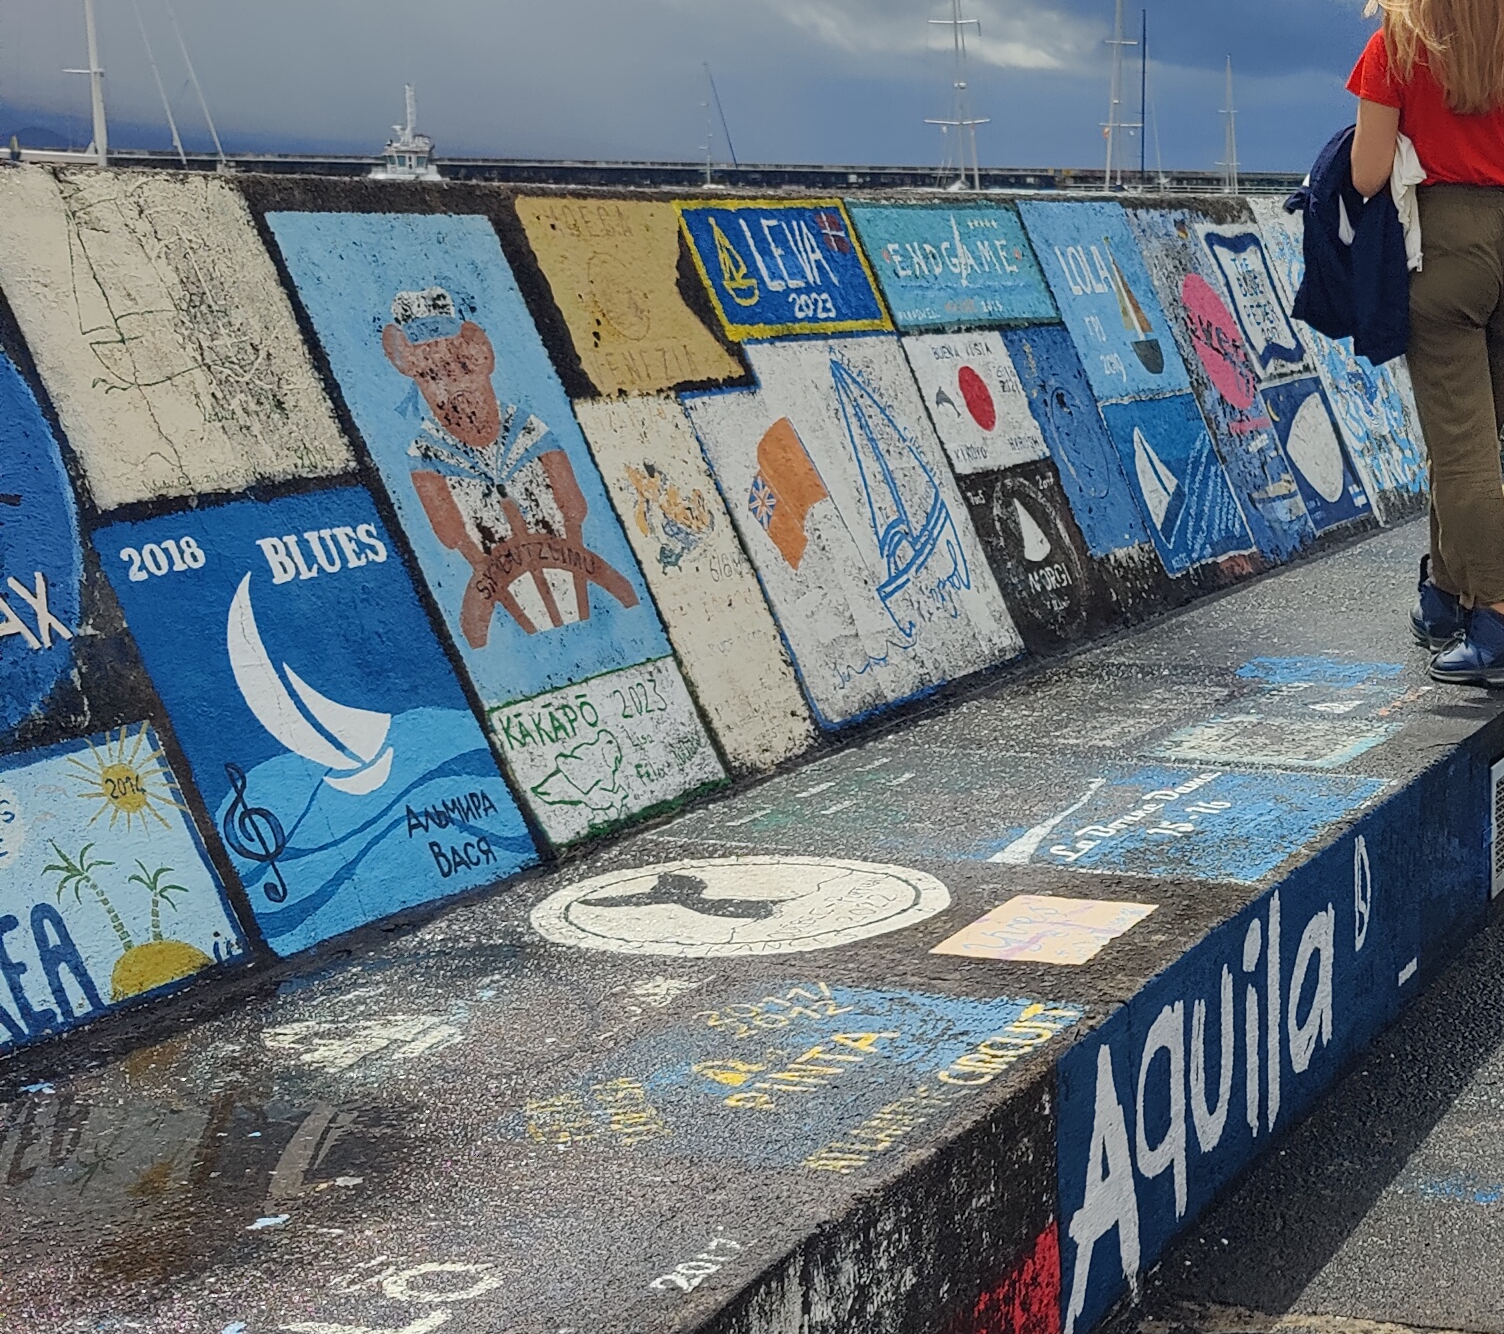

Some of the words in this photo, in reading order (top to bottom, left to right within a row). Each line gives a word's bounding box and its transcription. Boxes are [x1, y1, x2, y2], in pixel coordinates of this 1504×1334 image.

[739, 218, 839, 291] LEVA
[887, 240, 1018, 278] ENDGAME
[1054, 245, 1116, 296] LOLA
[788, 292, 836, 318] 2023
[119, 536, 206, 582] 2018
[256, 523, 388, 585] BLUES
[500, 694, 600, 750] KĀKĀPŌ
[613, 678, 668, 719] 2023
[406, 790, 497, 838] АЛЬМИРА
[428, 841, 499, 880] ВАСЯ
[724, 1030, 900, 1111] PINTA
